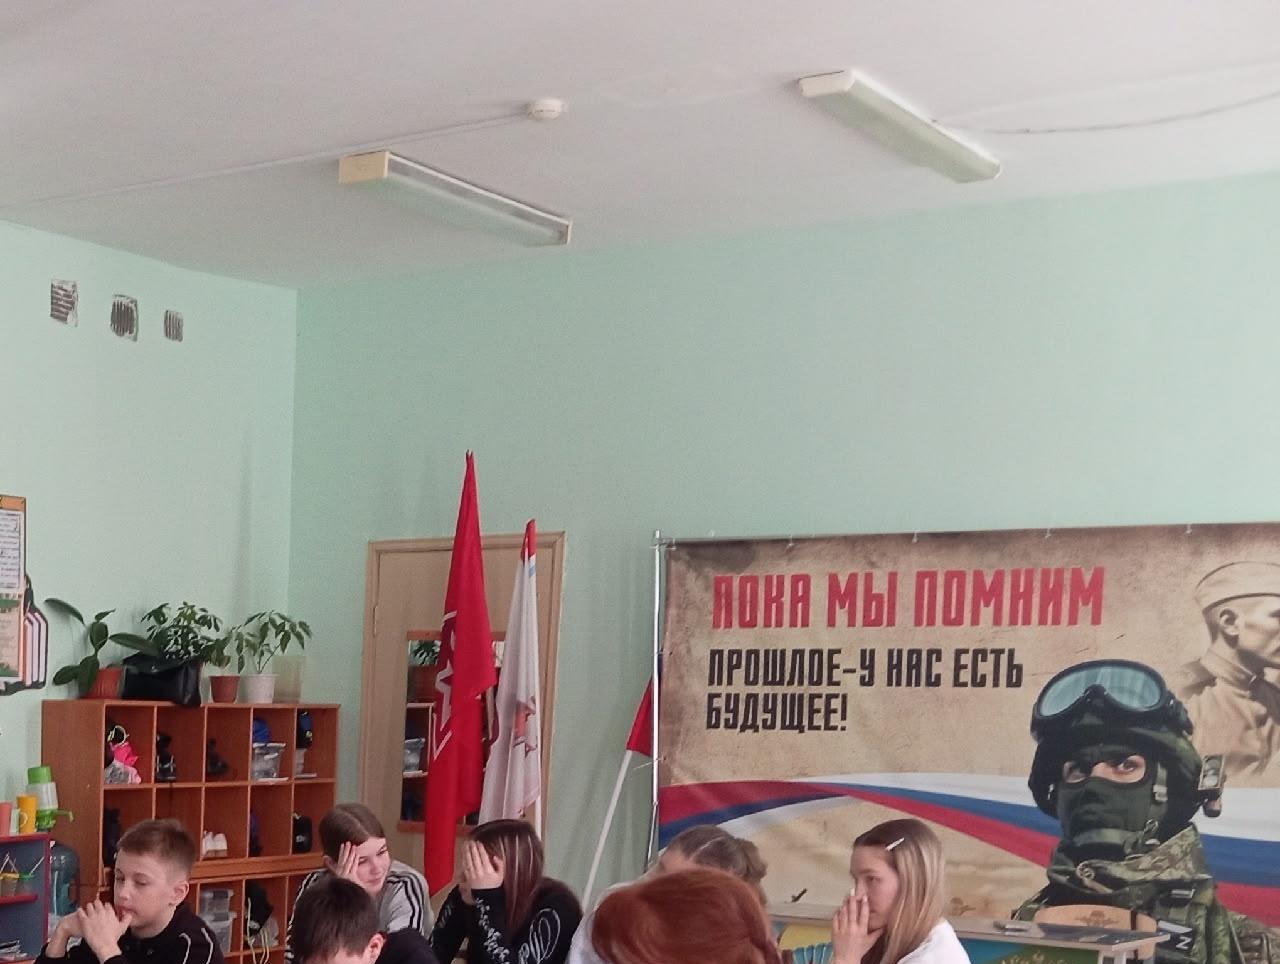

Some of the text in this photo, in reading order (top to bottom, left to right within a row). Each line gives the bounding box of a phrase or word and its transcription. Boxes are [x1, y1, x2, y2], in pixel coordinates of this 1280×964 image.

[712, 566, 1106, 629] ПОКА МЫ ПОМНИМ
[887, 648, 943, 687] НАС
[953, 647, 1024, 688] ЕСТЬ
[706, 692, 848, 734] БУДУЩЕЕ!
